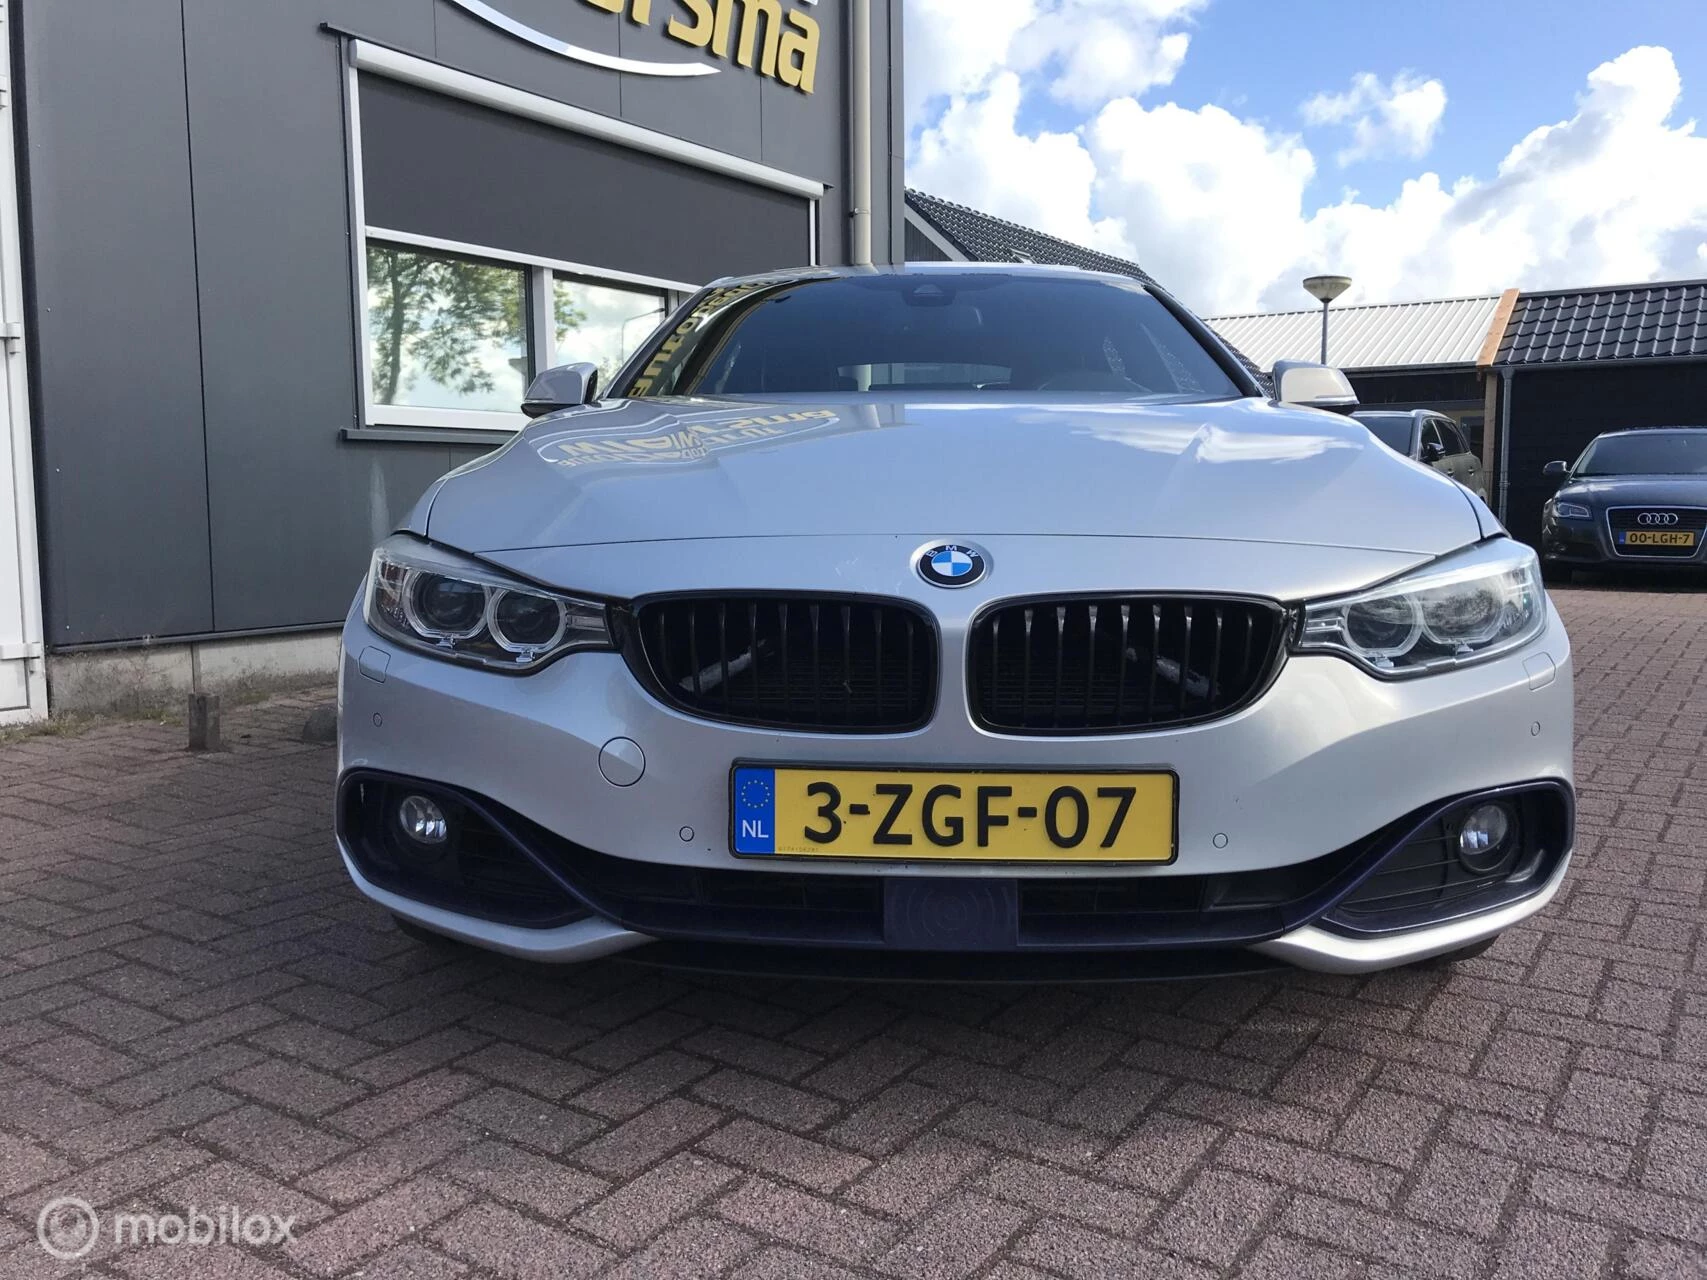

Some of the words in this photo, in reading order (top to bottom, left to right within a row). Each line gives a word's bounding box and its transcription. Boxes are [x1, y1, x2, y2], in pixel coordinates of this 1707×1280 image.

[1629, 533, 1690, 543] 00-LGH-7
[925, 545, 979, 558] BMW
[804, 781, 1137, 849] 3-ZGF-07
[742, 819, 769, 839] NL
